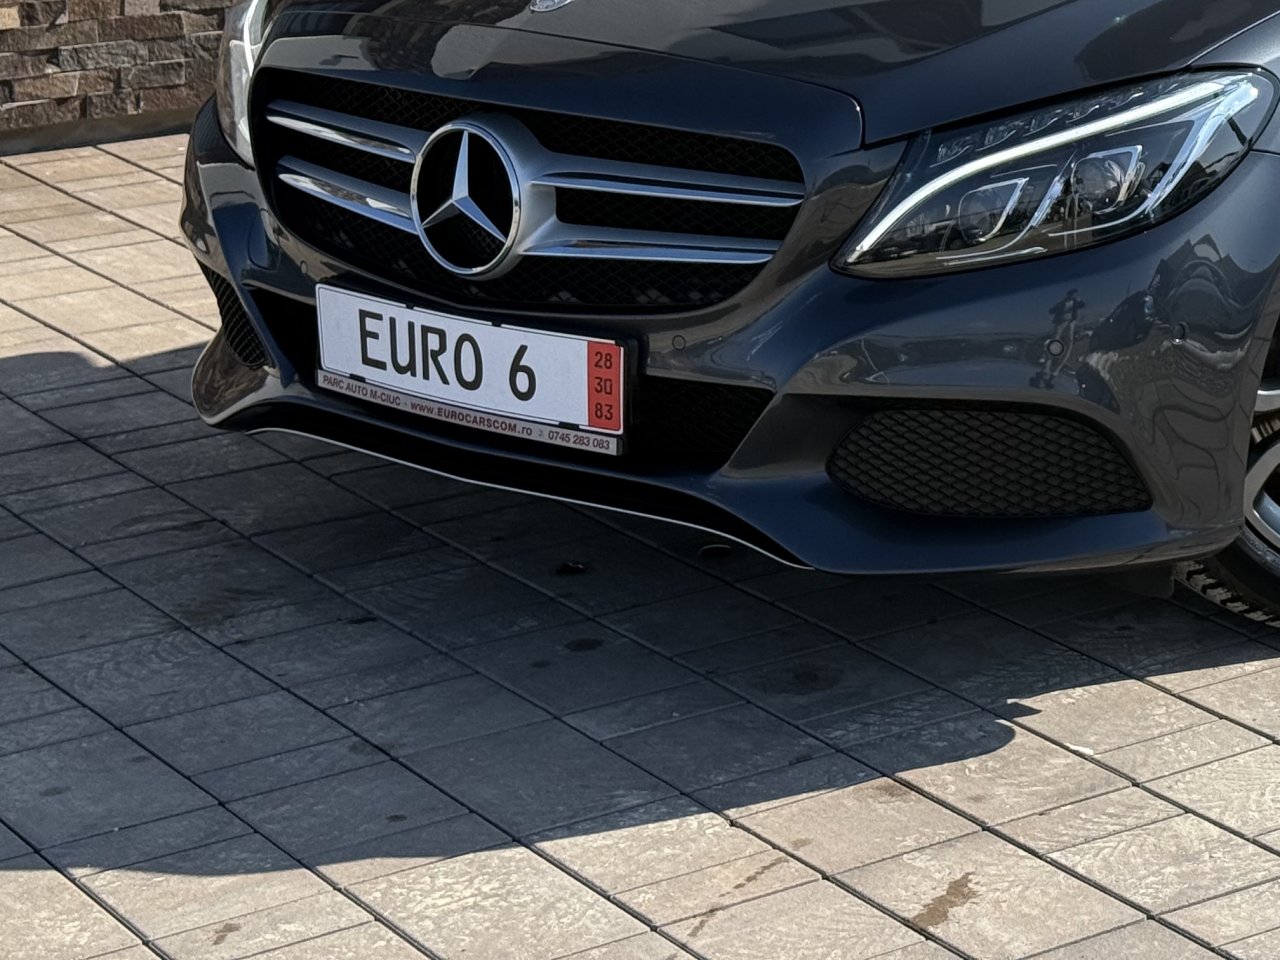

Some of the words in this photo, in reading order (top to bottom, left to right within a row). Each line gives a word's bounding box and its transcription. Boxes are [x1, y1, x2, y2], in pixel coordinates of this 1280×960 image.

[358, 308, 483, 391] EURO
[508, 344, 536, 402] 6
[594, 351, 613, 370] 28
[594, 376, 613, 396] 30
[322, 374, 344, 390] PARC
[345, 382, 368, 397] AUTO
[370, 390, 401, 406] M-CIUC
[410, 401, 533, 436] www.EUROCARSCOM.ro
[548, 430, 571, 444] 0745
[573, 434, 591, 447] 283
[592, 438, 610, 450] 083
[594, 402, 613, 421] 83
